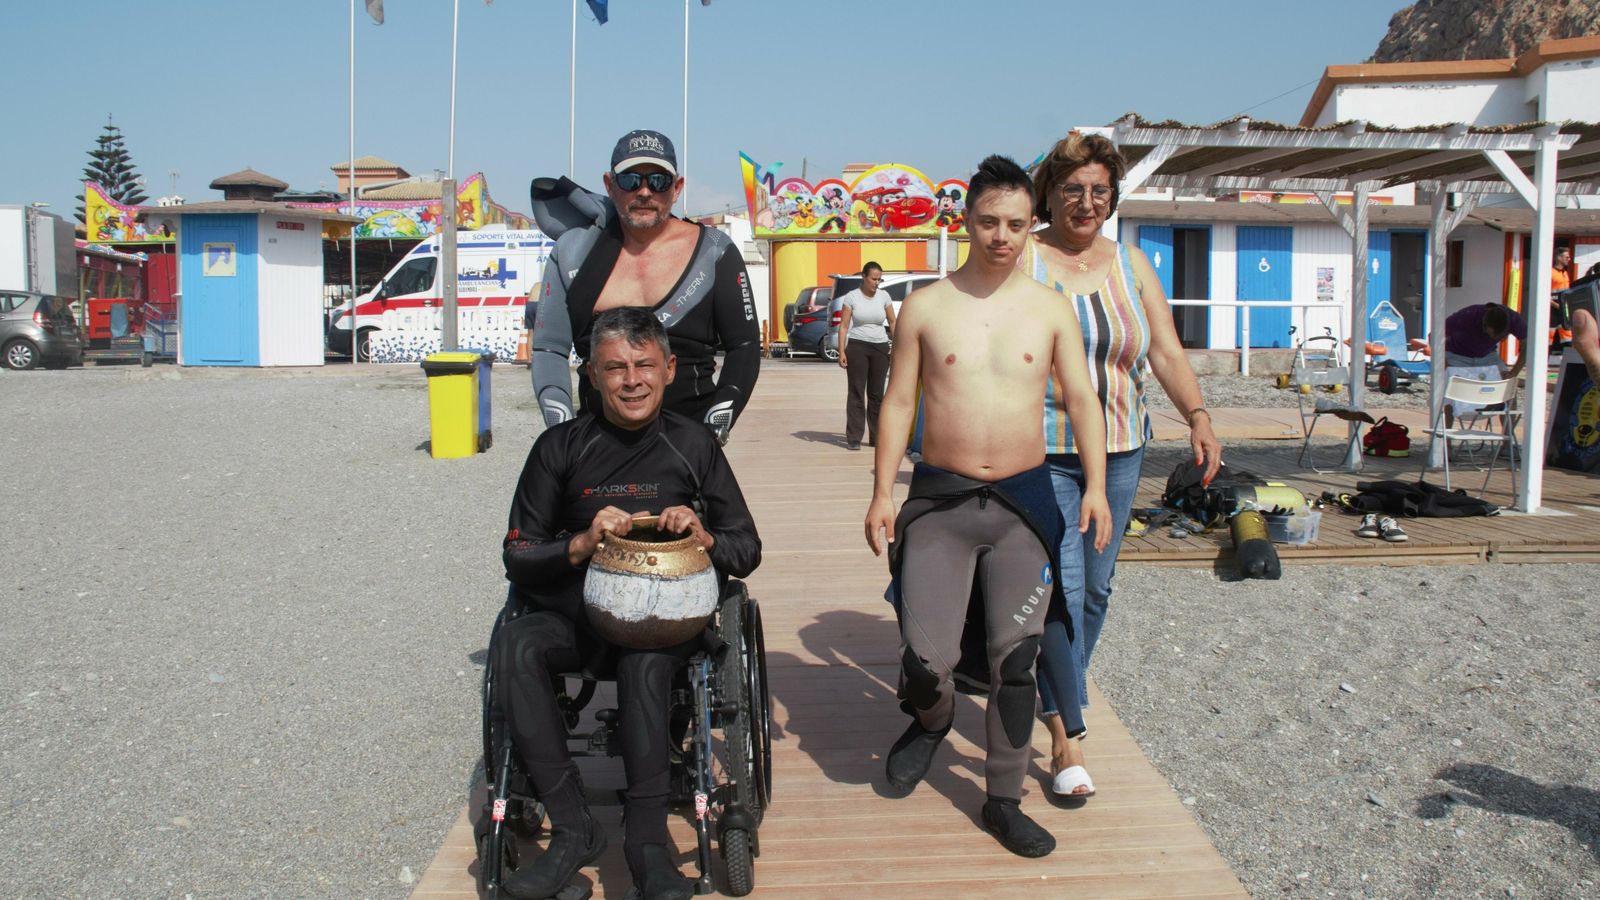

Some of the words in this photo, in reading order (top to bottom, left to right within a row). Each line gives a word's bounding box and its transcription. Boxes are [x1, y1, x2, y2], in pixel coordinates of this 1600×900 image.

[629, 138, 664, 151] DIVERS
[740, 271, 754, 321] mares
[1013, 586, 1045, 625] AQUA
